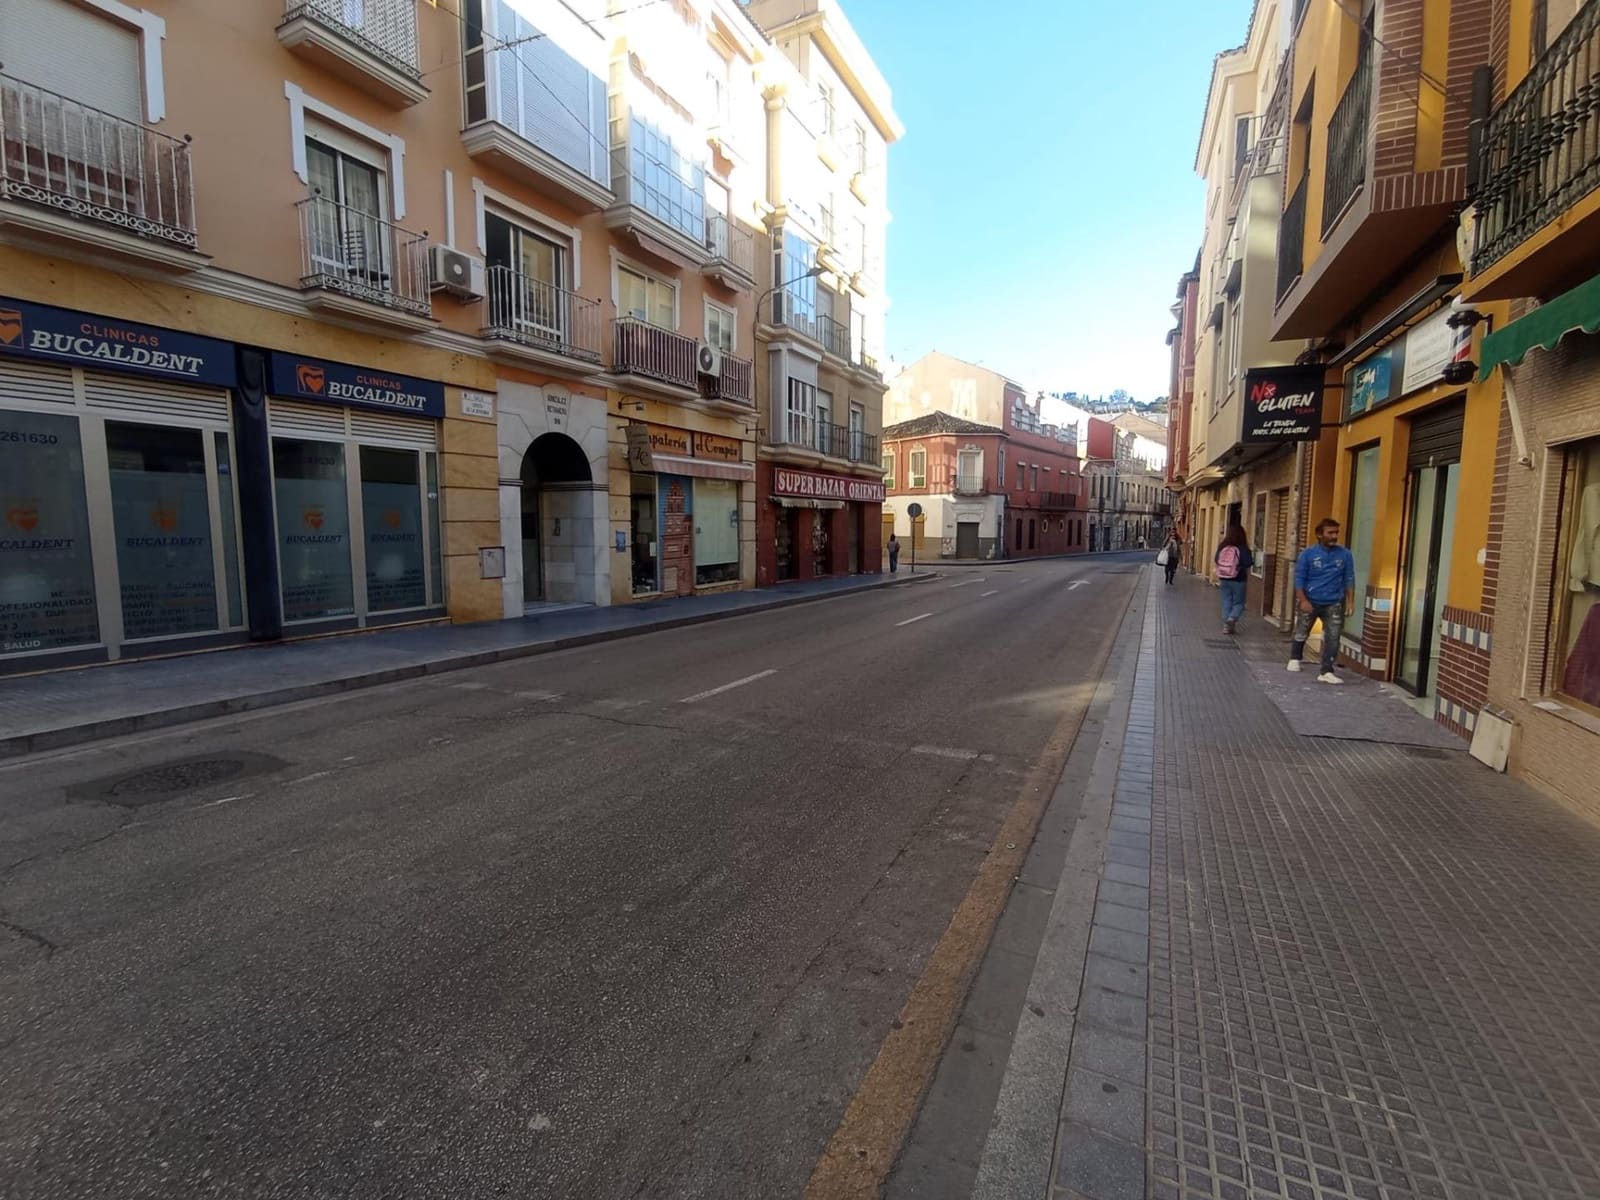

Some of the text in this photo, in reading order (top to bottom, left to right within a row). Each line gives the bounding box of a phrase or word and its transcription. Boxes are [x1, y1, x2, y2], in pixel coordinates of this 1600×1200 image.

[80, 323, 160, 347] CLINICAS
[30, 329, 203, 373] BUCALDENT
[328, 381, 427, 408] BUCALDENT
[356, 375, 401, 390] CLINICAS
[1258, 391, 1315, 413] GLUTEN
[778, 472, 885, 501] SUPER BAZAR ORIENTAL
[127, 536, 205, 547] BUCALDENT
